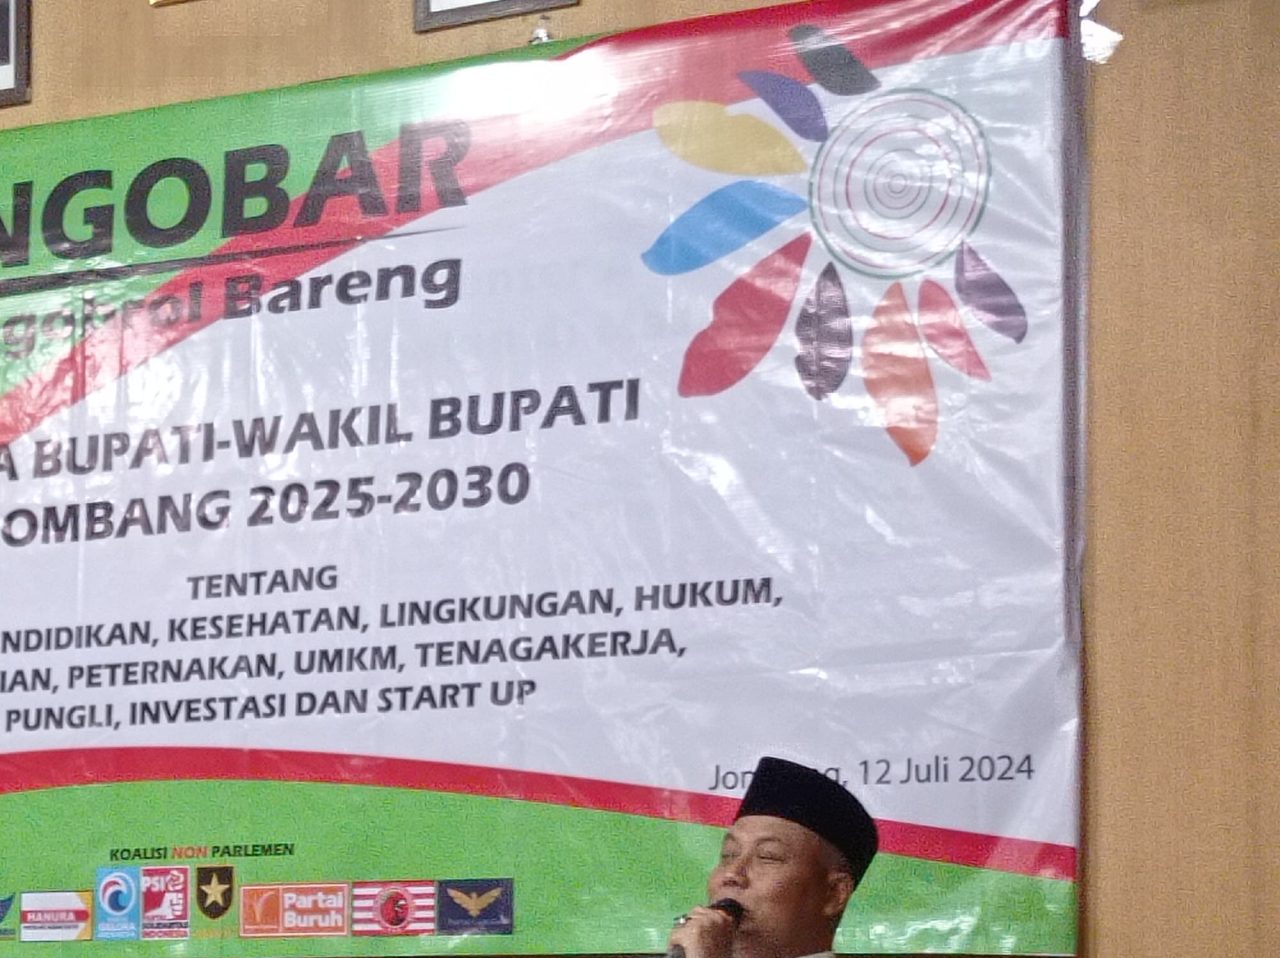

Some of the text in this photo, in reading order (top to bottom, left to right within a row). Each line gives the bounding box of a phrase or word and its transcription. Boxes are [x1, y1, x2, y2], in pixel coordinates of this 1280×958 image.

[224, 257, 462, 320] Bareng
[32, 403, 412, 479] BUPATI-WAKIL
[428, 378, 641, 440] BUPATI
[247, 462, 531, 527] 2025-2030
[187, 565, 338, 600] TENTANG
[168, 605, 370, 643] KESEHATAN,
[379, 588, 624, 628] LINGKUNGAN,
[633, 577, 783, 612] HUKUM,
[67, 652, 285, 690] PETERNAKAN,
[293, 644, 406, 674] UMKM,
[414, 628, 687, 668] TENAGAKERJA,
[5, 680, 536, 732] PUNGLI, INVESTASI DAN START UP
[860, 760, 892, 785] 12
[900, 755, 950, 785] Juli
[958, 754, 1036, 783] 2024
[109, 843, 295, 861] KOALISI NON PARLEMEN
[141, 875, 166, 893] PSI
[283, 892, 344, 908] Partai
[26, 911, 77, 922] HANURA
[284, 911, 343, 928] Buruh
